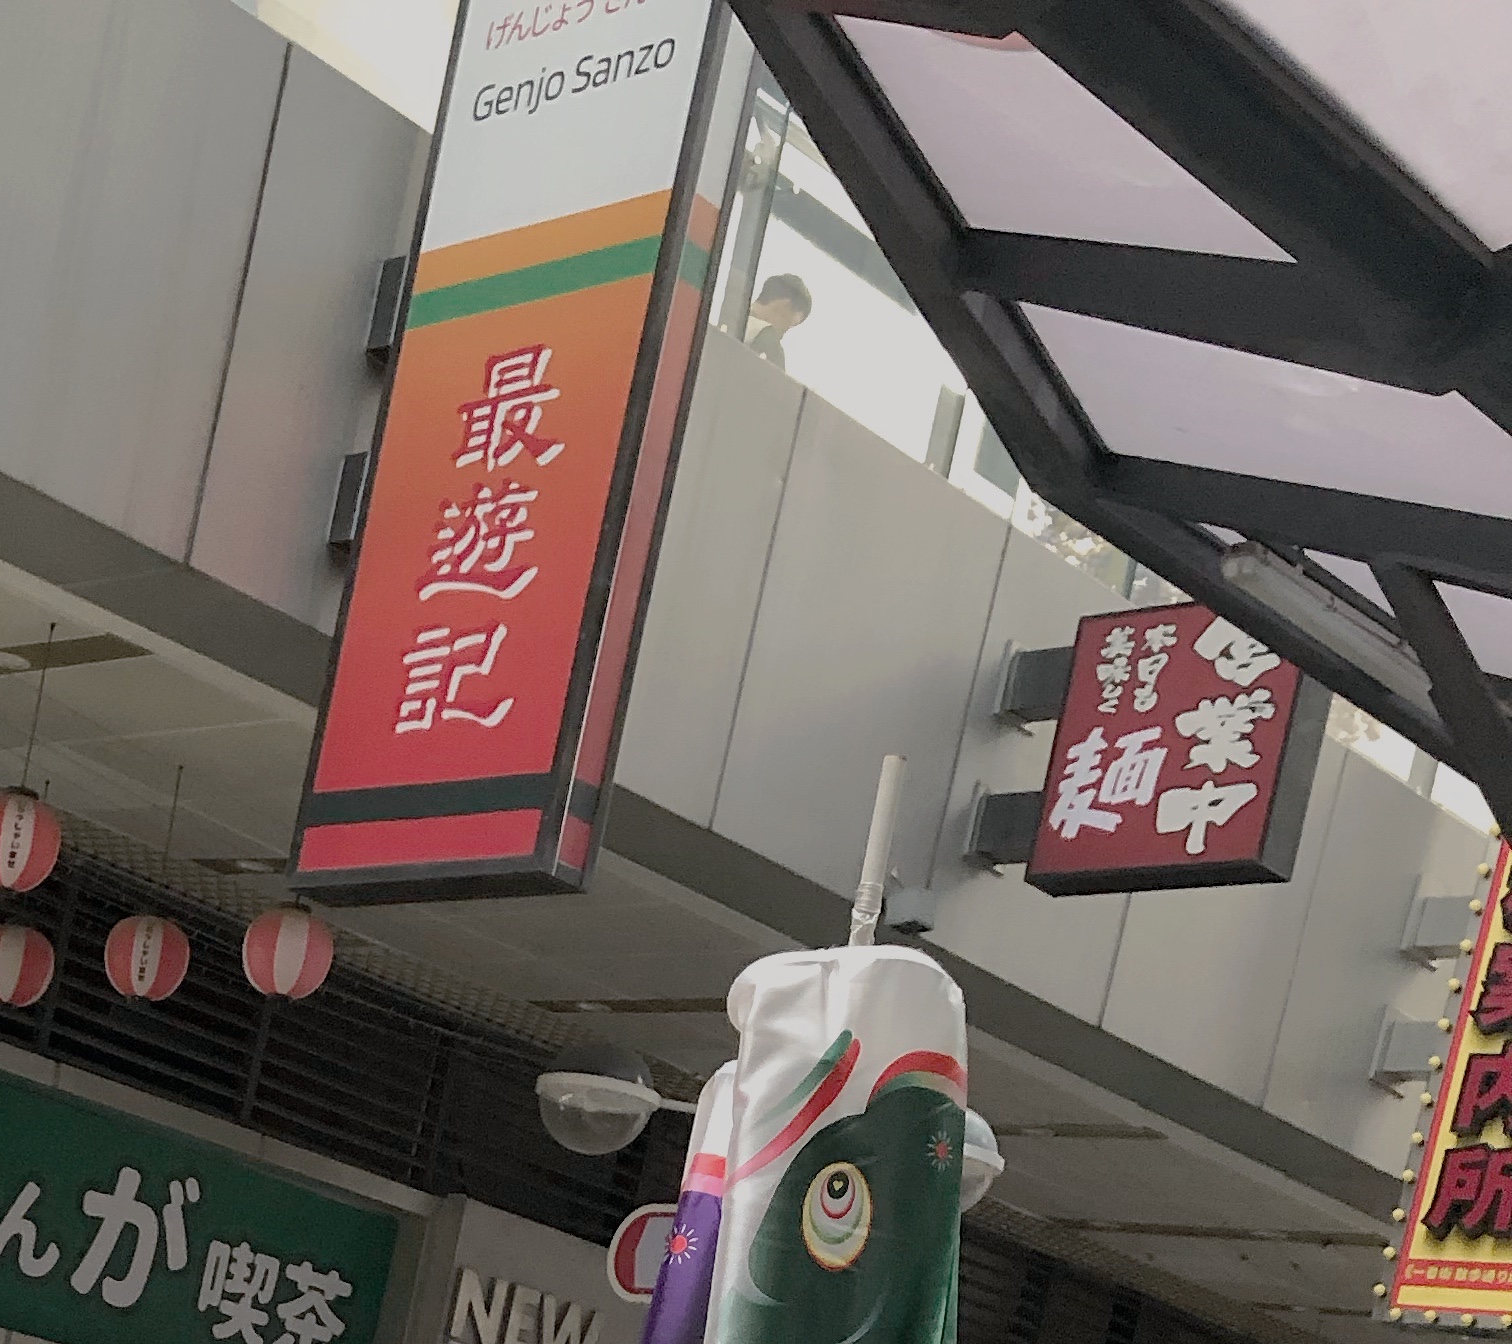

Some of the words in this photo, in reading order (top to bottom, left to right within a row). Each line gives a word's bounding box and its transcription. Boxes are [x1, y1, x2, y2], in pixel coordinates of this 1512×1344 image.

[486, 0, 646, 50] げんじょう
[473, 67, 565, 122] Genjo
[572, 38, 675, 94] Sanzo
[394, 344, 566, 735] 最遊記
